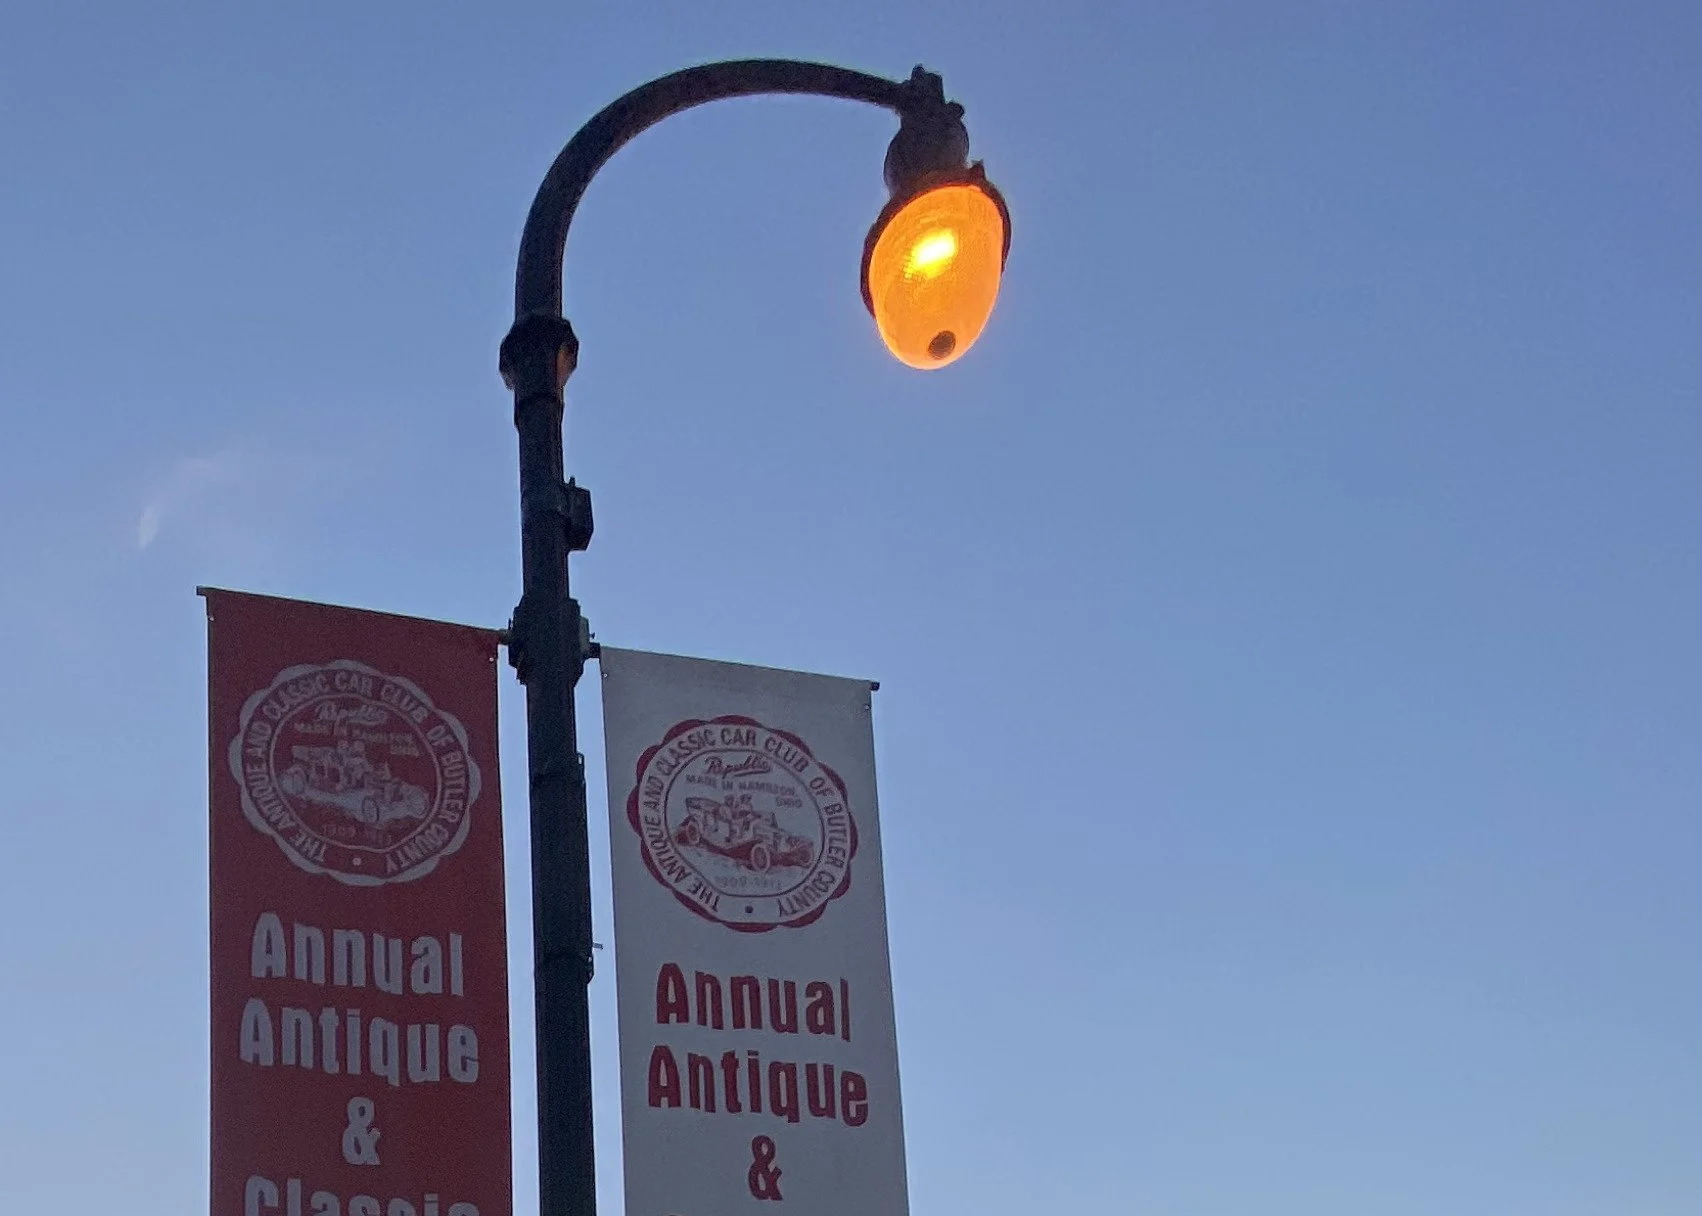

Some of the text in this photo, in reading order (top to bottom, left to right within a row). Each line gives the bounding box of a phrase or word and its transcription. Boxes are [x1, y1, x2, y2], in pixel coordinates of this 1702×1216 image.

[262, 675, 330, 721] CLASSIC
[334, 671, 374, 697] CAR
[380, 683, 429, 723] CLUB
[426, 724, 456, 748] OF
[440, 751, 467, 823] BUTLER
[289, 830, 328, 863] THE
[643, 727, 849, 918] THE ANTIQUE AND CLASSIC CAR CLUB OF BUTLER COUNTY
[251, 911, 464, 997] Annual
[656, 962, 851, 1042] Annual
[239, 998, 480, 1087] Antique
[648, 1044, 869, 1127] Antique
[342, 1096, 382, 1166] &
[748, 1135, 784, 1201] &
